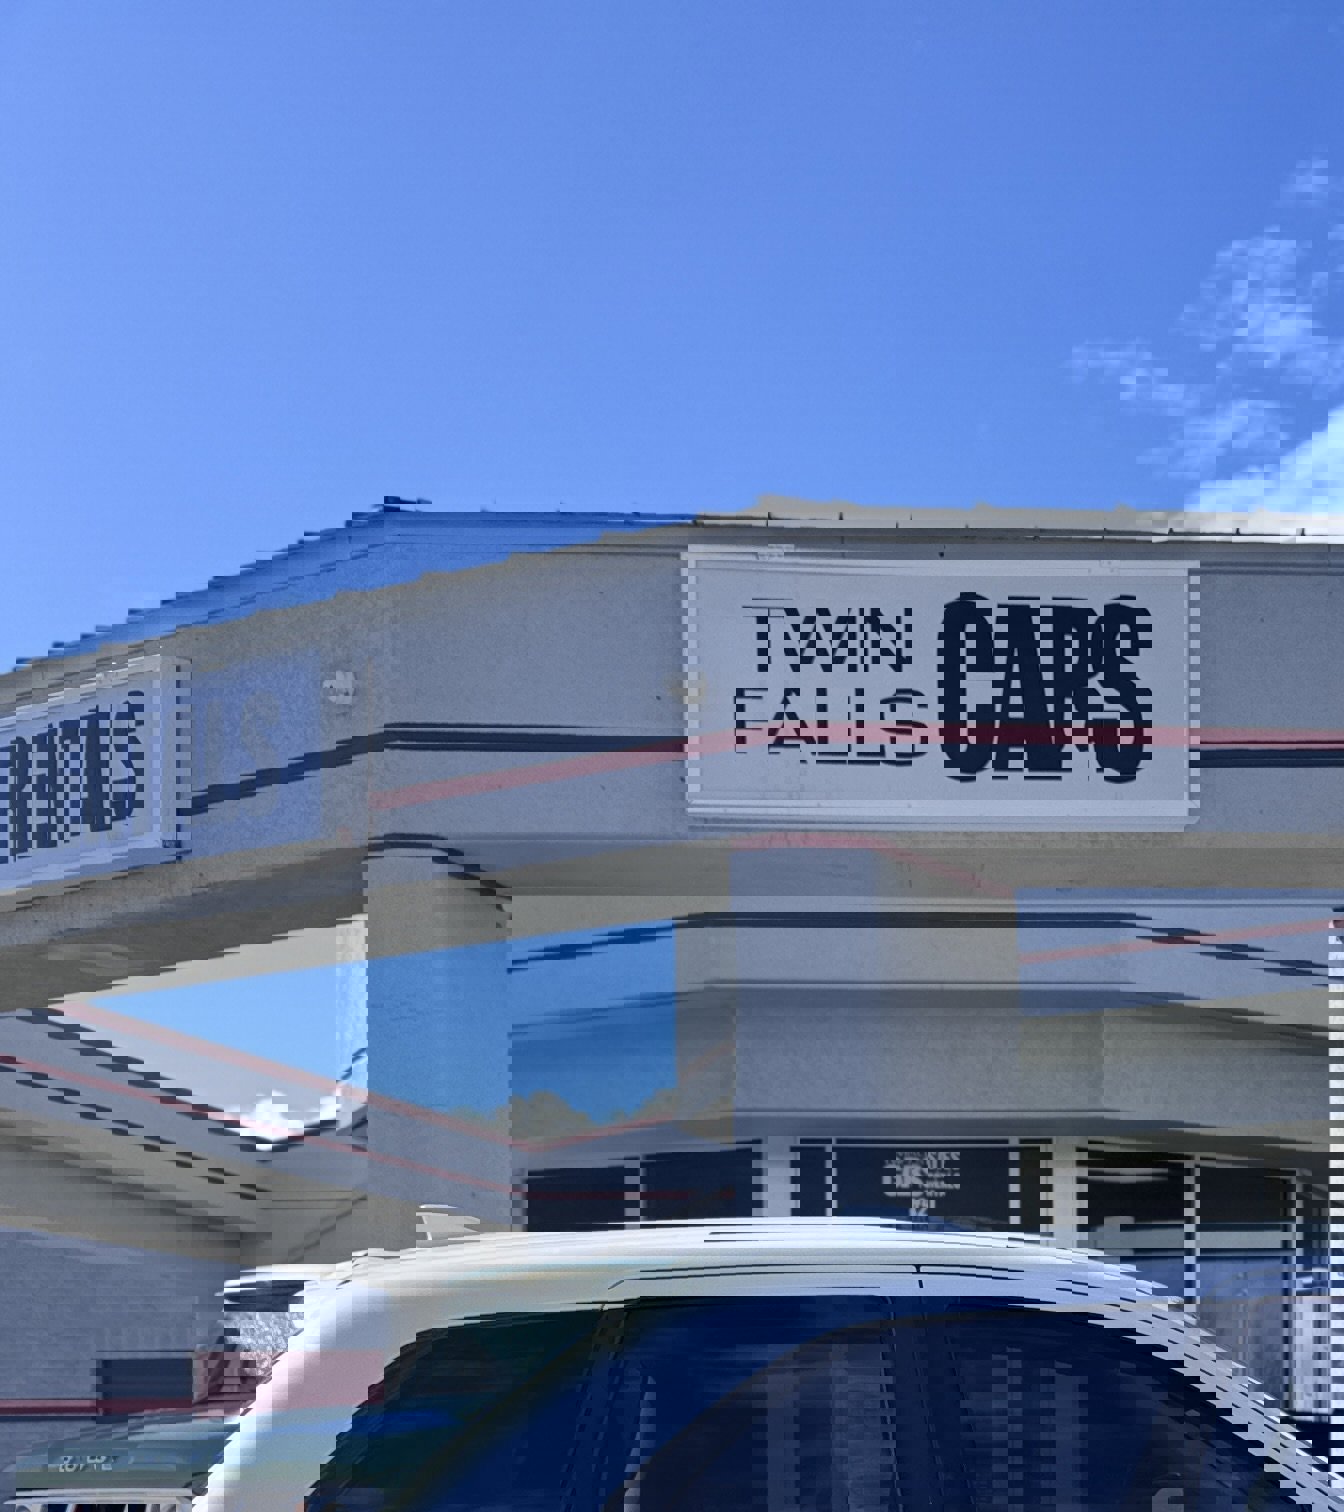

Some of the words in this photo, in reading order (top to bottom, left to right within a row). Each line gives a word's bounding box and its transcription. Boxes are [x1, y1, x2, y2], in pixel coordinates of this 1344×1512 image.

[742, 597, 912, 672] TWIN
[734, 687, 928, 766] FALLS
[937, 592, 1152, 784] CARS
